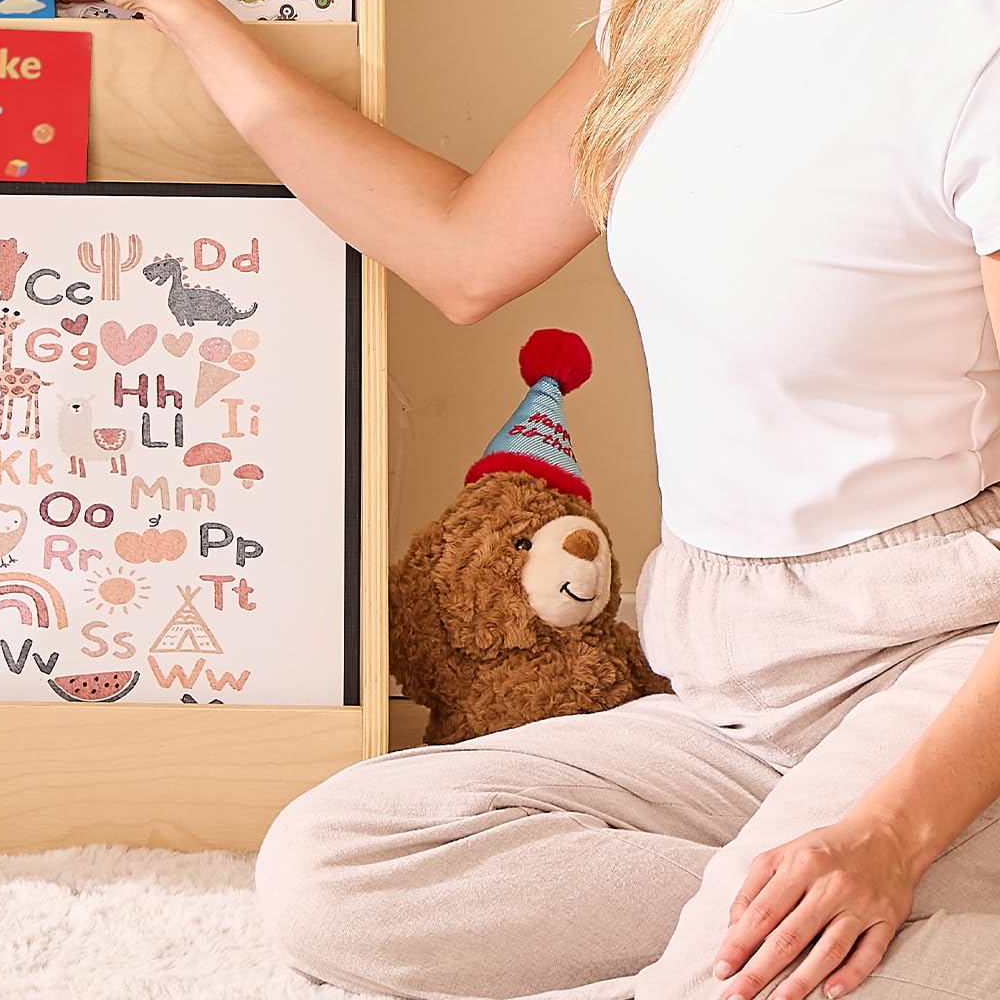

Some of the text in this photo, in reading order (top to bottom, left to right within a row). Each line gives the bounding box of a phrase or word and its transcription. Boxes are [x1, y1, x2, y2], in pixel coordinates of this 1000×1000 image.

[193, 237, 260, 274] Dd
[24, 268, 94, 305] Cc
[25, 328, 98, 371] Gg
[114, 372, 183, 410] Hh
[221, 398, 262, 438] Ii
[39, 491, 115, 529] Oo
[131, 475, 216, 512] Mm
[43, 534, 103, 572] Rr
[200, 522, 264, 567] Pp
[200, 574, 257, 611] Tt
[1, 637, 60, 676] Vv
[81, 621, 136, 660] Ss
[147, 655, 251, 692] Ww
